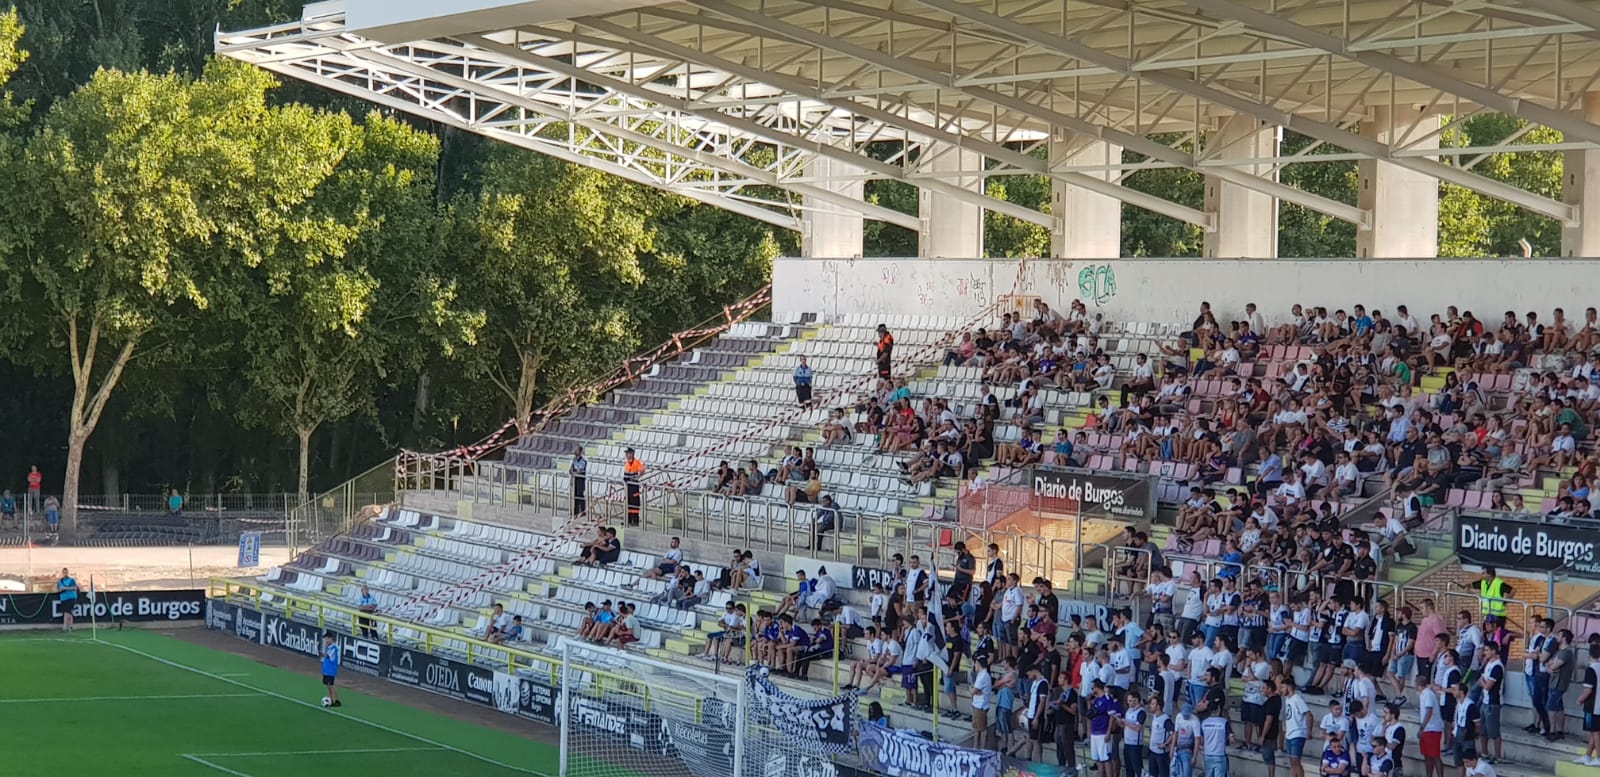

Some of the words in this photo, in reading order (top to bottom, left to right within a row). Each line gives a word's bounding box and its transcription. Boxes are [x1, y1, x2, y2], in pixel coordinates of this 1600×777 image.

[1034, 476, 1066, 499] Diario
[1068, 479, 1082, 500] de
[1085, 481, 1125, 510] Burgos
[1461, 523, 1508, 553] Diario
[1511, 527, 1532, 555] de
[1536, 532, 1594, 568] Burgos
[111, 596, 134, 616] de
[138, 597, 201, 620] Burgos
[279, 621, 320, 656] CaixaBank
[343, 636, 381, 665] HCB
[426, 663, 460, 691] OJEDA
[467, 671, 493, 693] Canon
